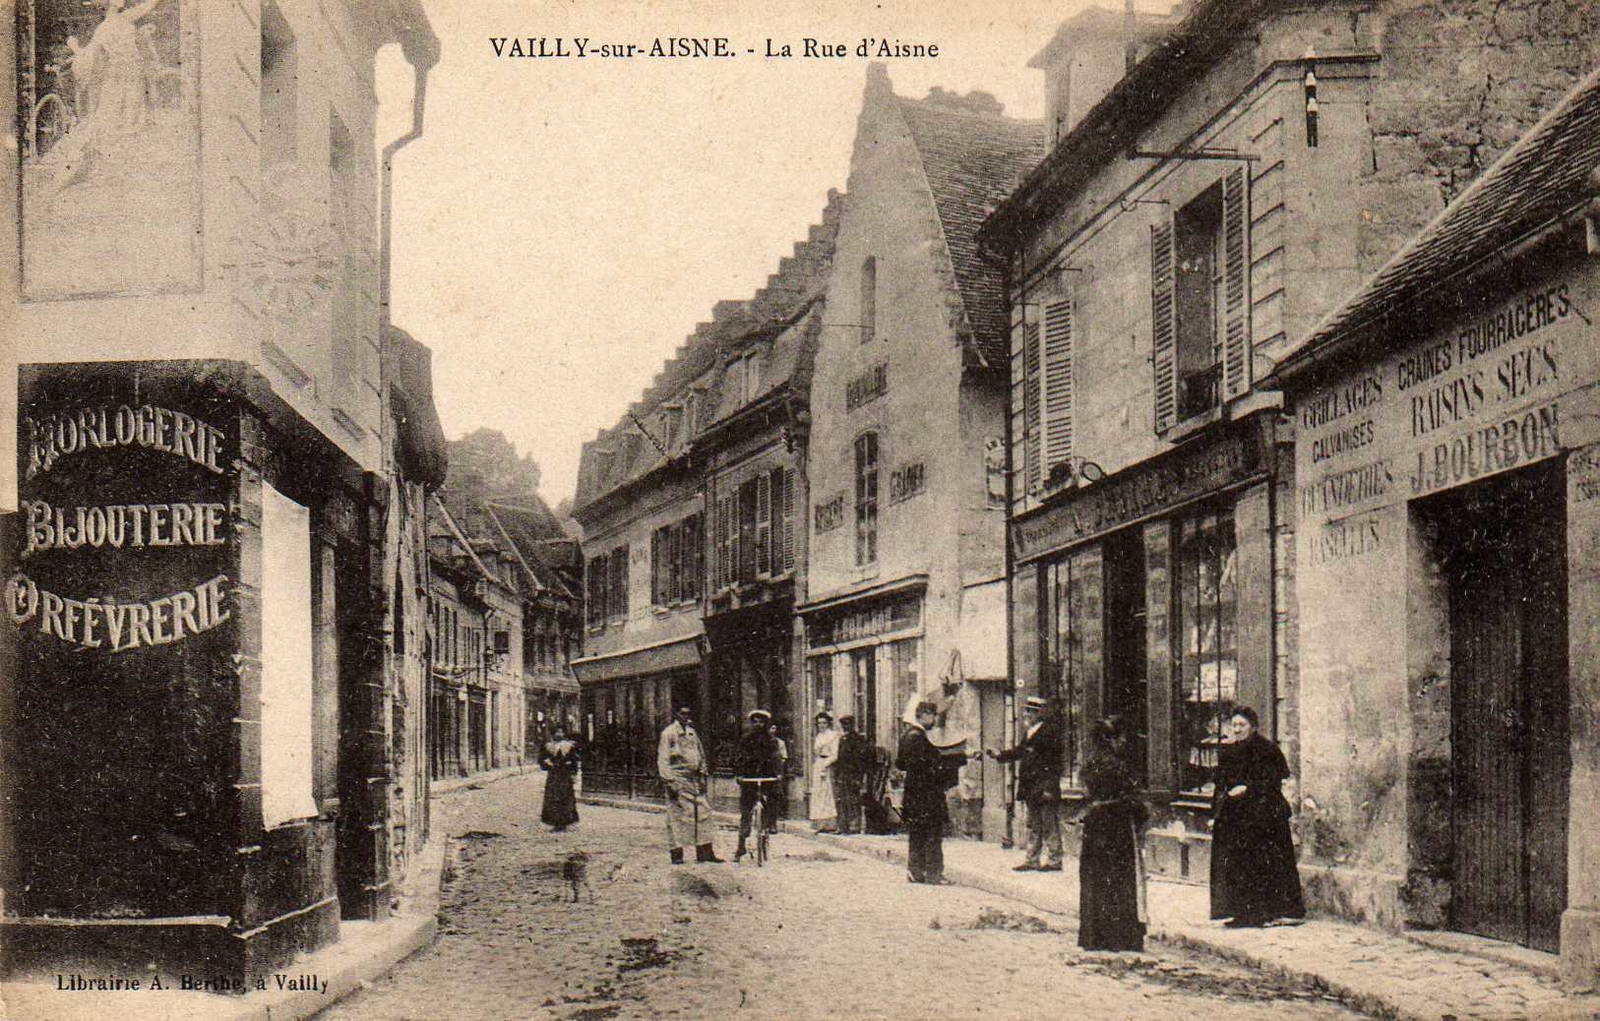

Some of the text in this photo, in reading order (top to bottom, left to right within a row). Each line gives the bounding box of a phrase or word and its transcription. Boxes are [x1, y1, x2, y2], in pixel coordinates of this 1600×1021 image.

[1412, 340, 1560, 437] RAISINS SECS
[23, 404, 226, 480] HORLOGERIE
[20, 499, 227, 560] BIJOUTERIE
